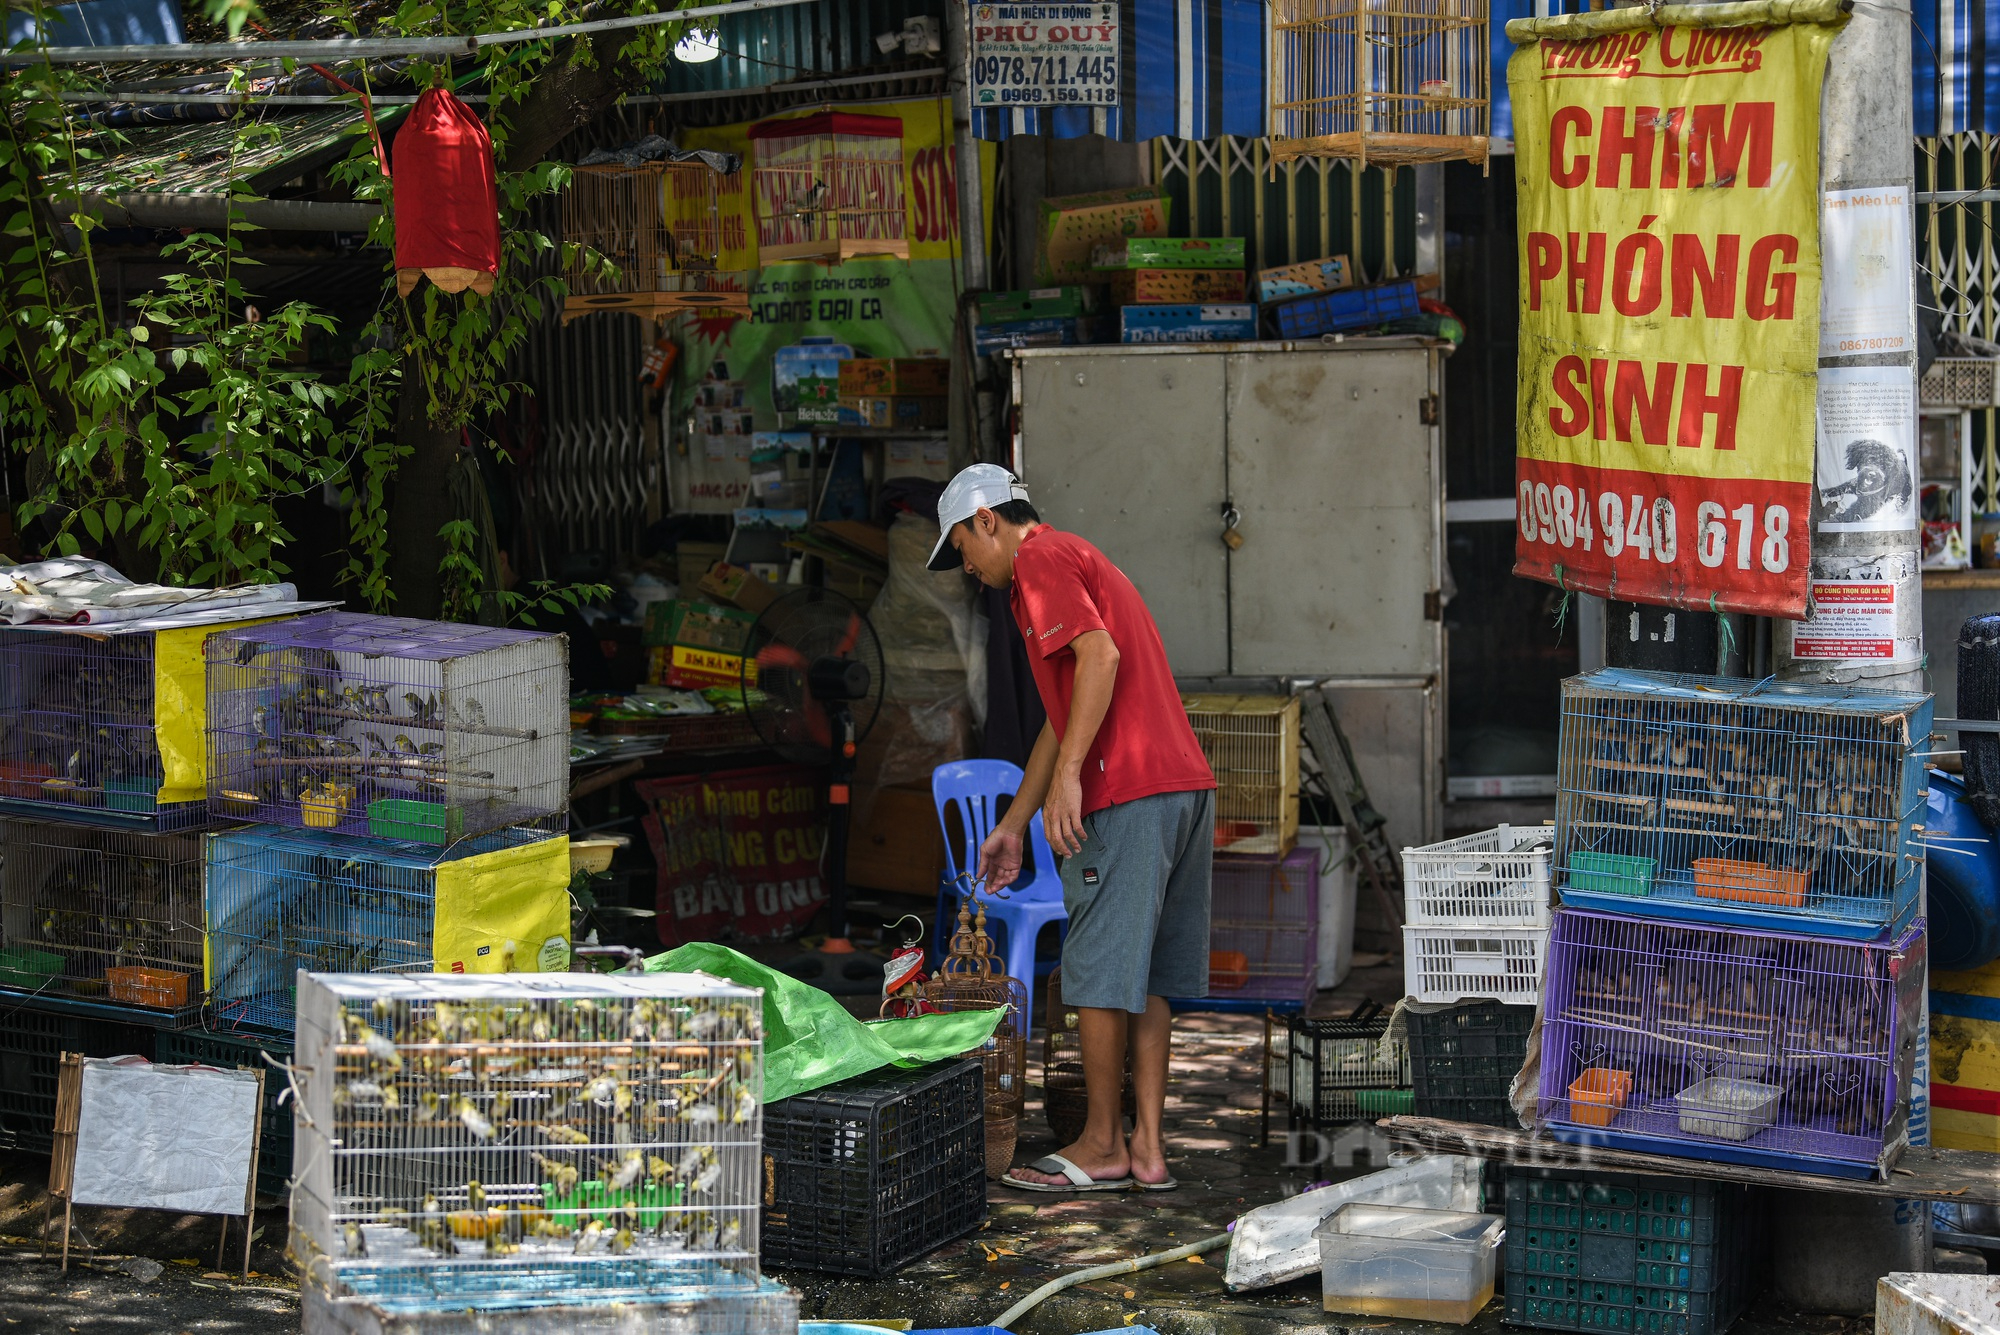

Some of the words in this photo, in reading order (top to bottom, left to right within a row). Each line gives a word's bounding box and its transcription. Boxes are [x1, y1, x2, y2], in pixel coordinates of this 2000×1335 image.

[999, 5, 1018, 19] MÁI
[1021, 5, 1046, 19] HIÊN
[1062, 5, 1091, 21] ĐỘNG
[975, 21, 1038, 42] PHÚ
[1048, 21, 1117, 42] QUÝ
[975, 55, 1115, 85] 0978.711.445
[1001, 88, 1116, 101] 0969.159.118
[1550, 102, 1774, 188] CHIM
[911, 145, 959, 243] SIN
[1851, 194, 1881, 207] Mèo
[1528, 215, 1798, 321] PHÓNG
[751, 297, 811, 323] HOÀNG
[819, 298, 853, 325] ĐẠI
[861, 298, 883, 319] CA
[1840, 336, 1904, 351] 0867807209
[1549, 355, 1744, 450] SINH
[797, 407, 838, 422] Heineke
[1520, 480, 1593, 551] 0984
[1599, 491, 1677, 563] 940
[1697, 501, 1789, 573] 618
[1847, 606, 1860, 614] CÁC
[685, 652, 707, 667] BIA
[724, 660, 742, 675] NỘ
